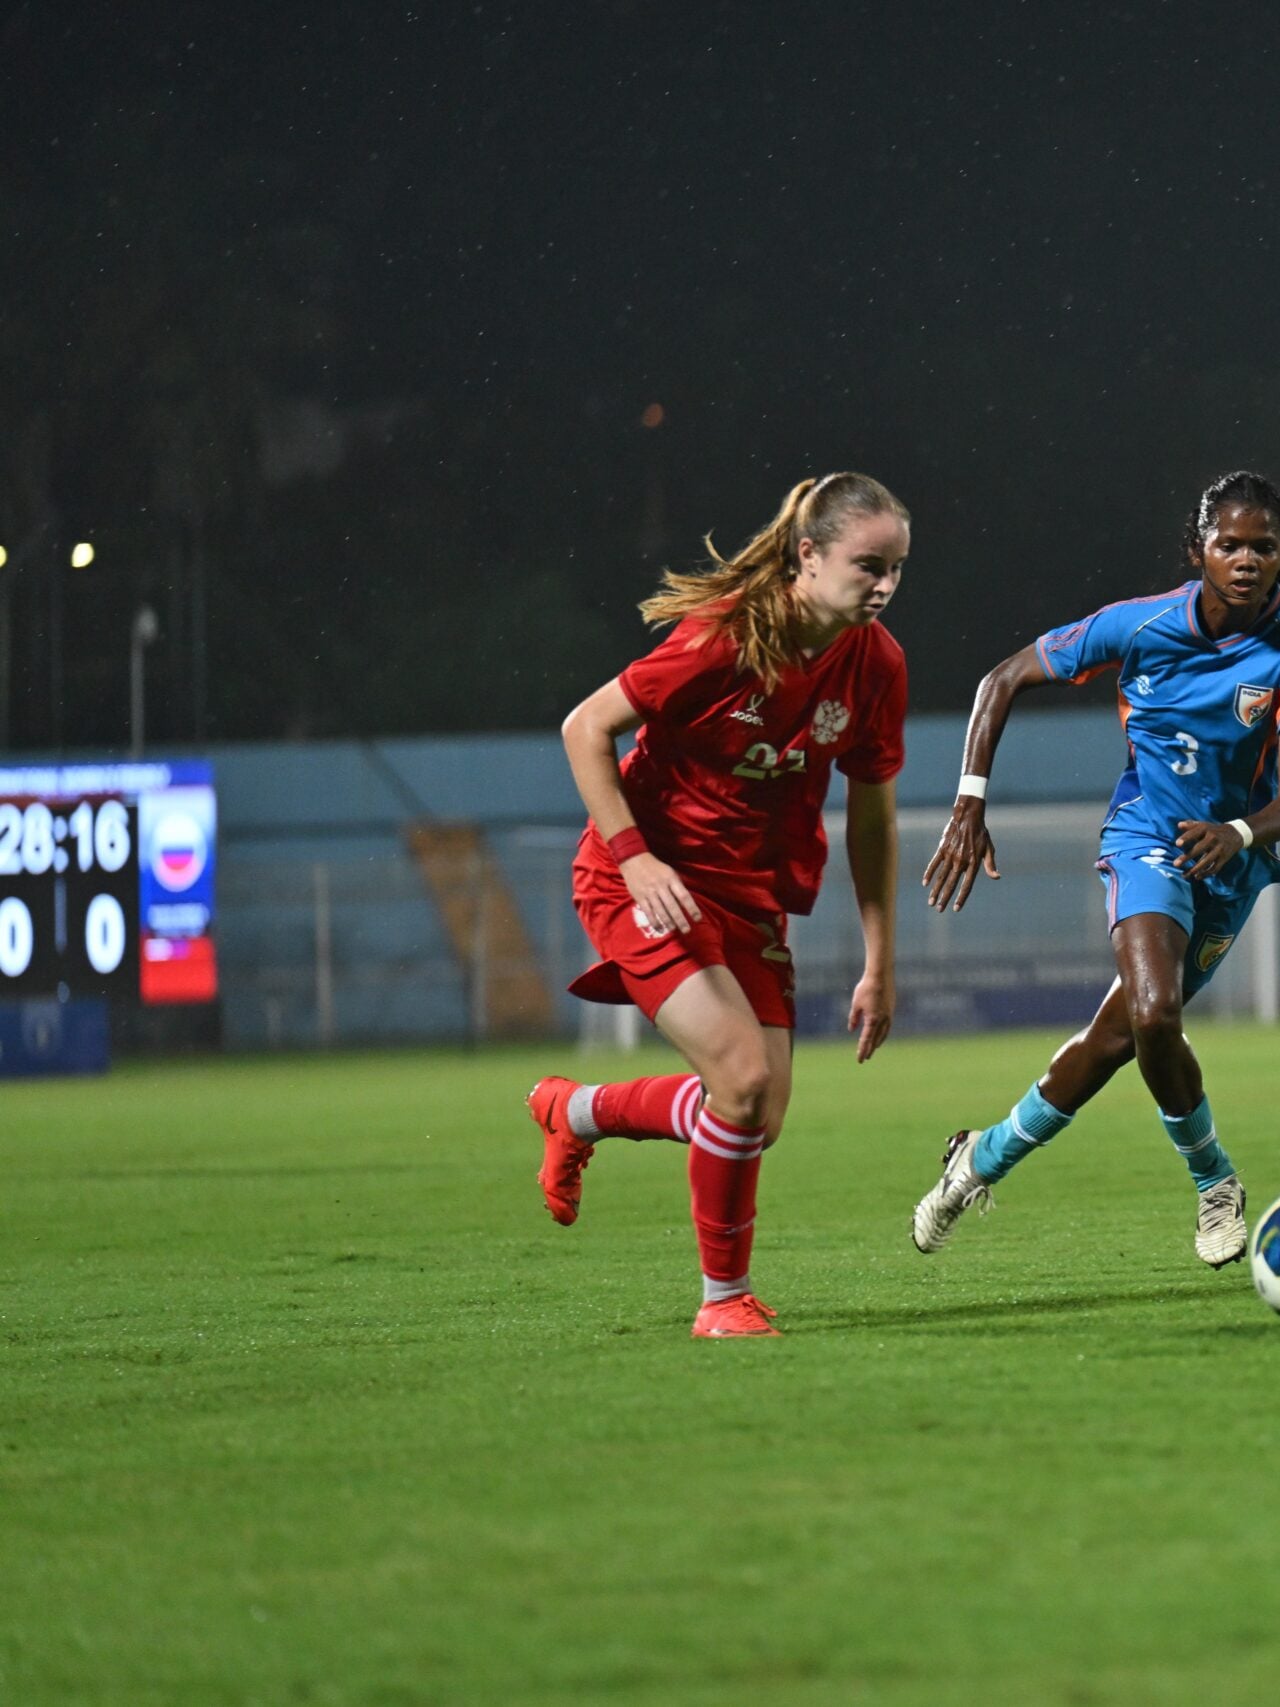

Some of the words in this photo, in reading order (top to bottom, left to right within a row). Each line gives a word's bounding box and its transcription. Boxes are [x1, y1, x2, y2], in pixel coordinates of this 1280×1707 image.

[1171, 731, 1199, 776] 3
[0, 800, 131, 875] 28:16
[0, 897, 33, 977] 0
[86, 894, 125, 974] 0
